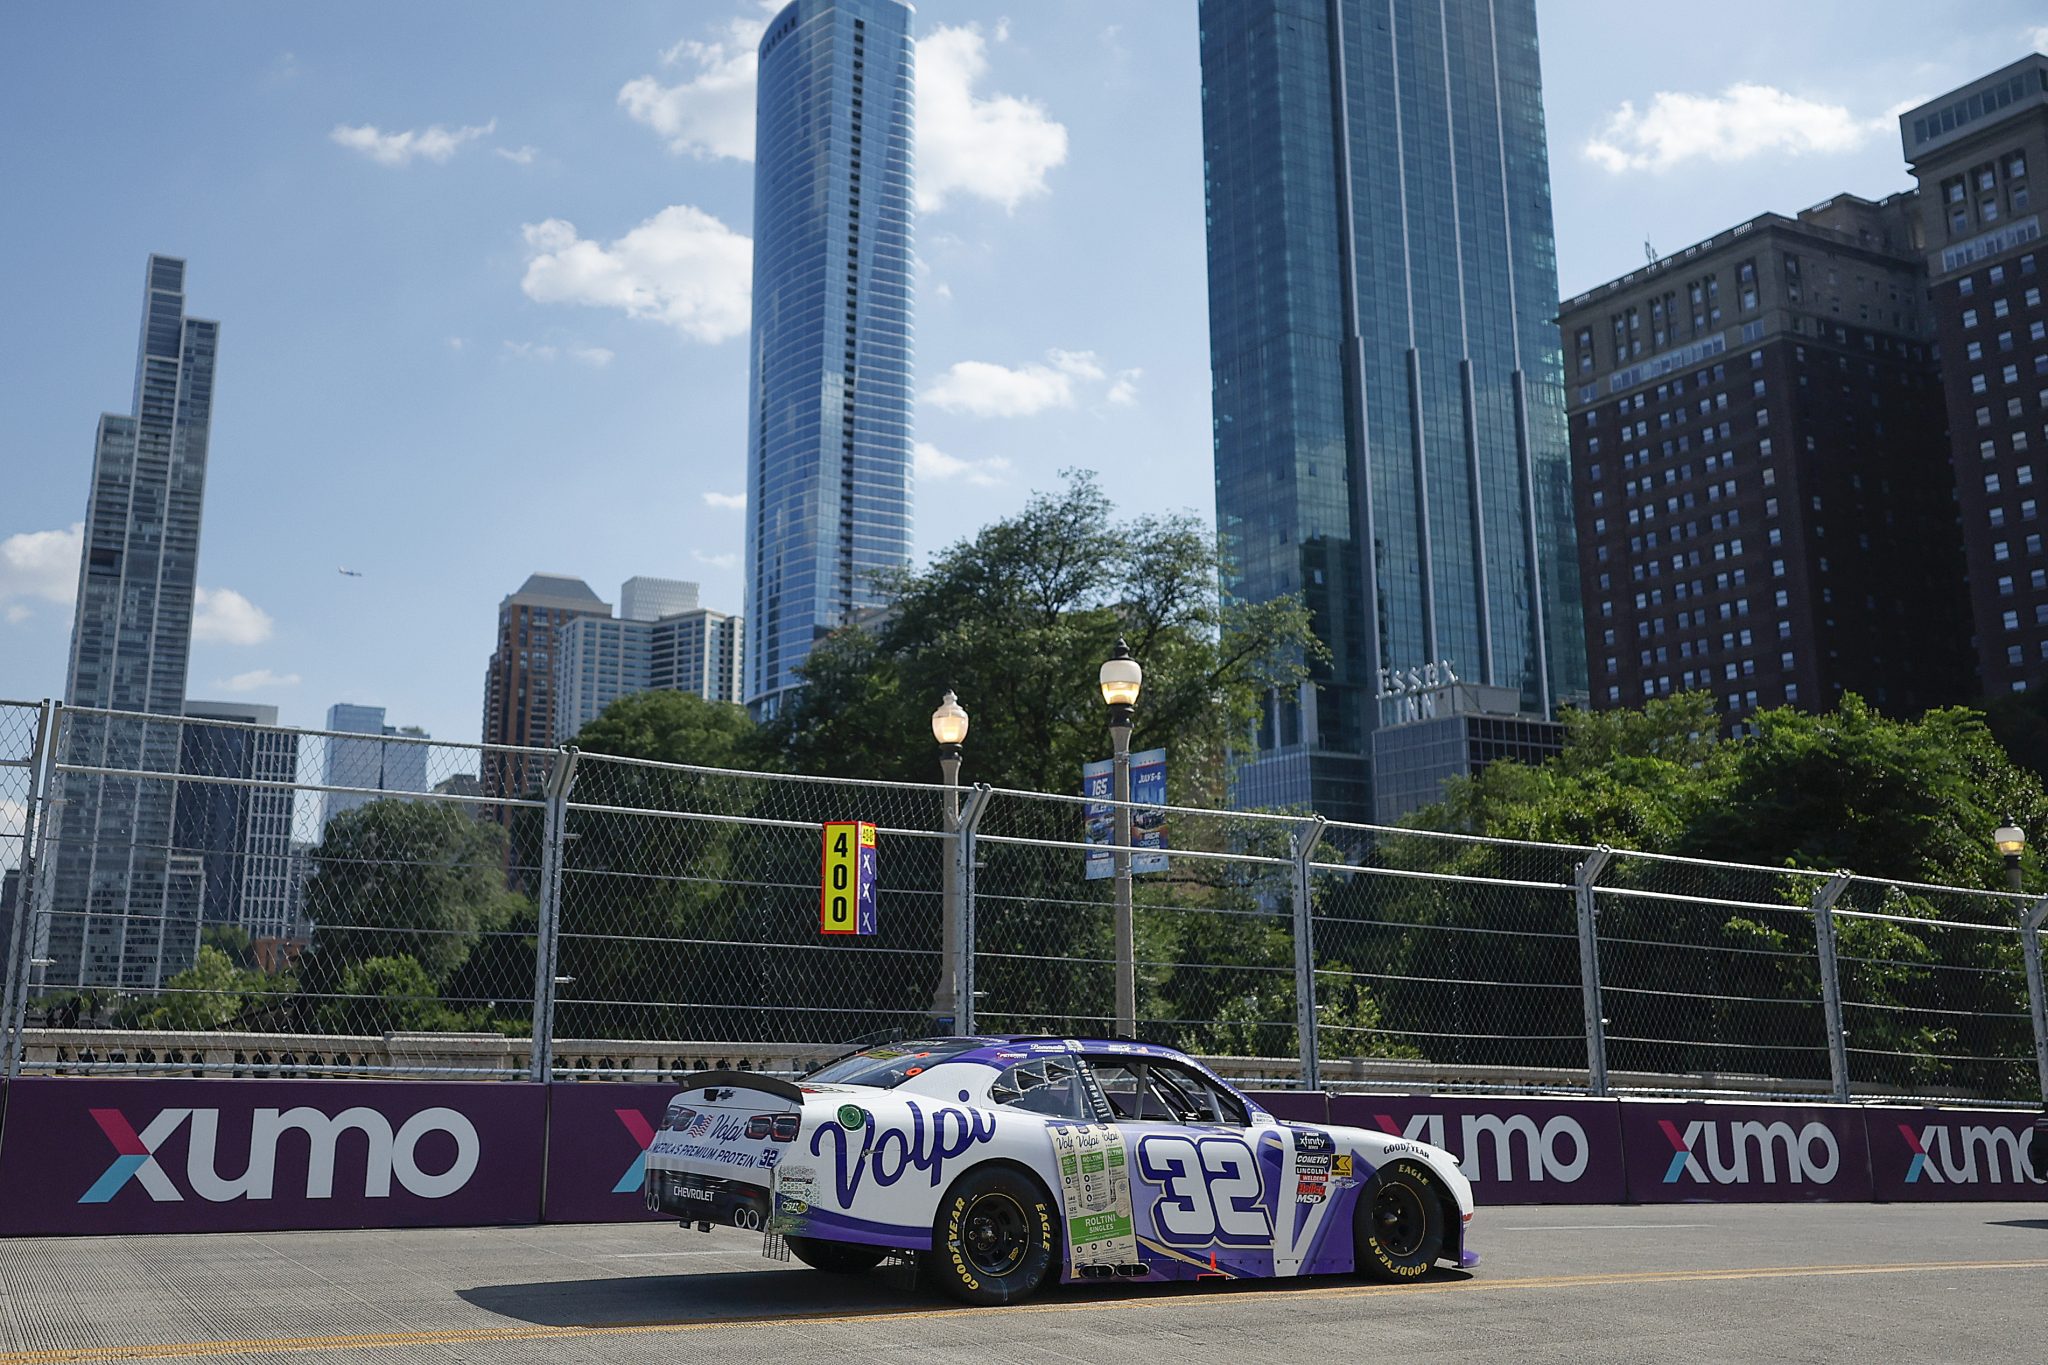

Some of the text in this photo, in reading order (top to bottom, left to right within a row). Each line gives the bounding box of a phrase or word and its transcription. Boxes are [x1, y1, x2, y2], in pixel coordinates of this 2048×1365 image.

[1092, 777, 1109, 797] 165
[833, 832, 849, 924] 400
[709, 1113, 747, 1145] Volpi
[810, 1089, 996, 1210] Volpi
[1075, 1134, 1100, 1149] Volpi
[1300, 1136, 1325, 1148] xfinity
[1383, 1142, 1430, 1159] GOODYEAR
[1658, 1120, 1840, 1184] xumo
[78, 1106, 480, 1203] xumo
[652, 1142, 757, 1169] MERICA'S PREMIUM PROTEIN
[758, 1148, 779, 1168] 32
[1297, 1155, 1329, 1164] COMETIC
[1296, 1167, 1324, 1175] LINCOLN
[1398, 1164, 1430, 1186] EAGLE
[673, 1185, 715, 1202] CHEVROLET
[1138, 1135, 1274, 1246] 32
[1296, 1194, 1322, 1203] MSD
[1035, 1203, 1051, 1252] EAGLE
[1085, 1213, 1116, 1227] ROLTINI
[1089, 1223, 1114, 1234] SINGLES
[947, 1197, 979, 1290] GOODYEAR
[1368, 1236, 1428, 1277] GOODYEAR
